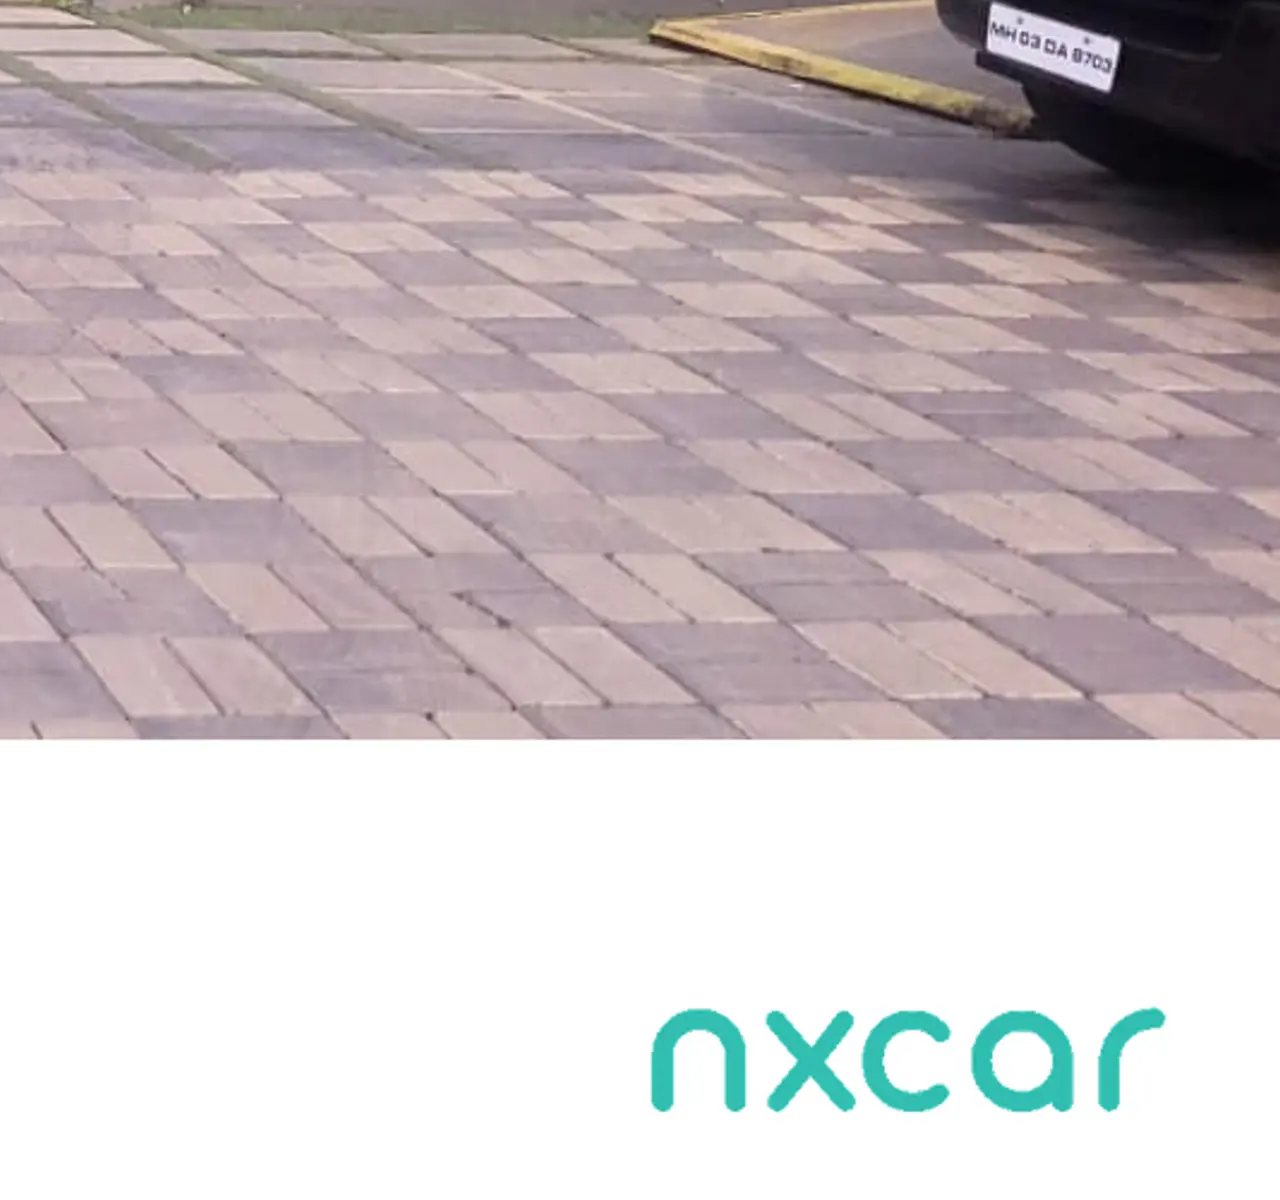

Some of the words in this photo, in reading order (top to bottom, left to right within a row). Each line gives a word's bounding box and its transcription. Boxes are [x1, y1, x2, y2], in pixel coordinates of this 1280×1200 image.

[990, 21, 1017, 43] MH
[1019, 30, 1041, 50] 03
[1043, 37, 1069, 60] DA
